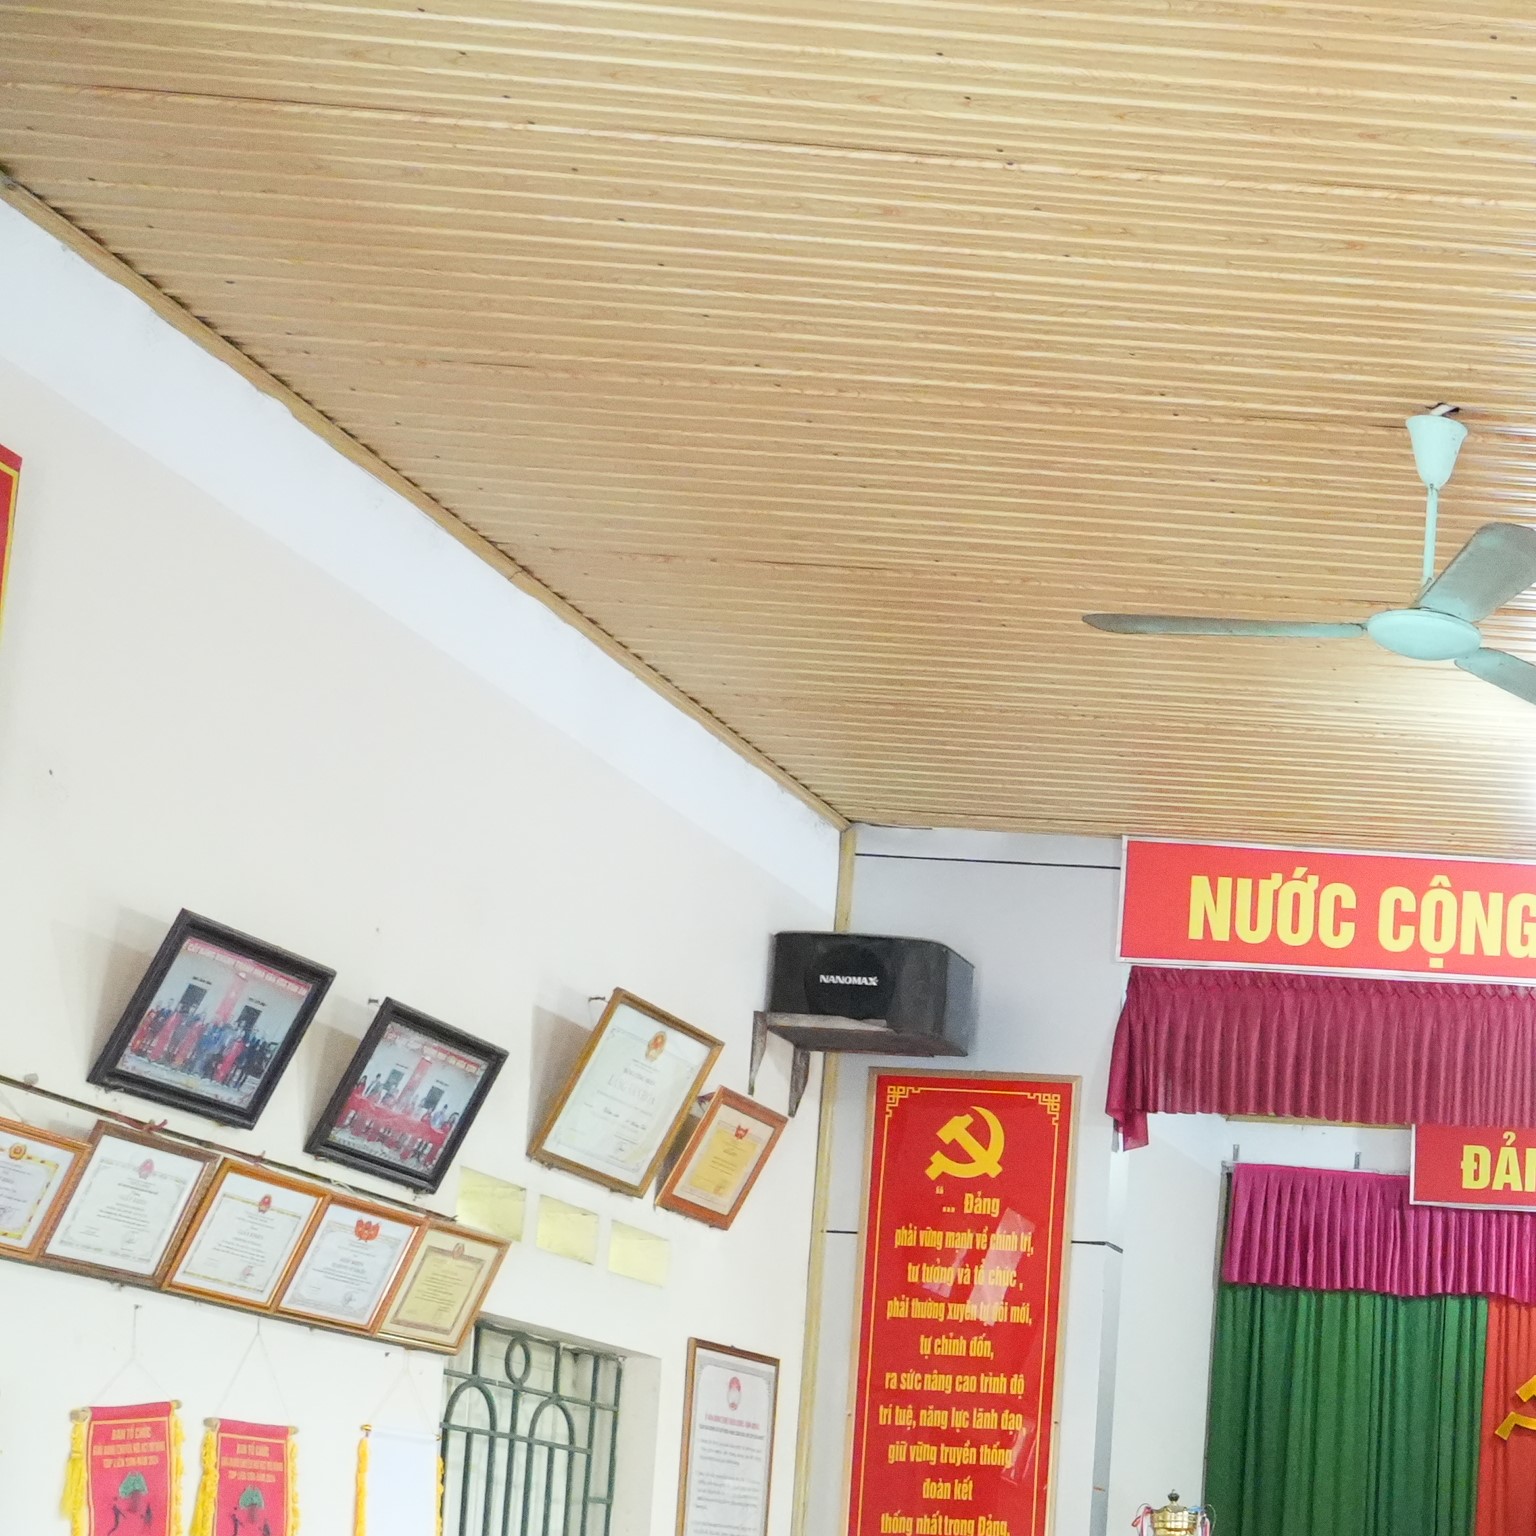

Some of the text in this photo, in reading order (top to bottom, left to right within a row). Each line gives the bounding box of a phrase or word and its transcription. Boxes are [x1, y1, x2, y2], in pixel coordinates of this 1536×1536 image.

[1188, 868, 1355, 949] NƯỚC
[819, 974, 879, 987] NANOMAX
[964, 1191, 1000, 1217] Đảng
[957, 1264, 971, 1285] và
[920, 1335, 932, 1360] tự
[934, 1332, 966, 1356] chỉnh
[885, 1369, 1025, 1399] ra sức nâng cao trình độ
[879, 1404, 892, 1425] trí
[919, 1405, 948, 1429] năng
[951, 1407, 969, 1433] lực
[973, 1407, 998, 1430] lãnh
[888, 1441, 908, 1464] giữ
[923, 1475, 973, 1500] đoàn kết
[881, 1509, 913, 1536] thống
[916, 1510, 942, 1535] nhất
